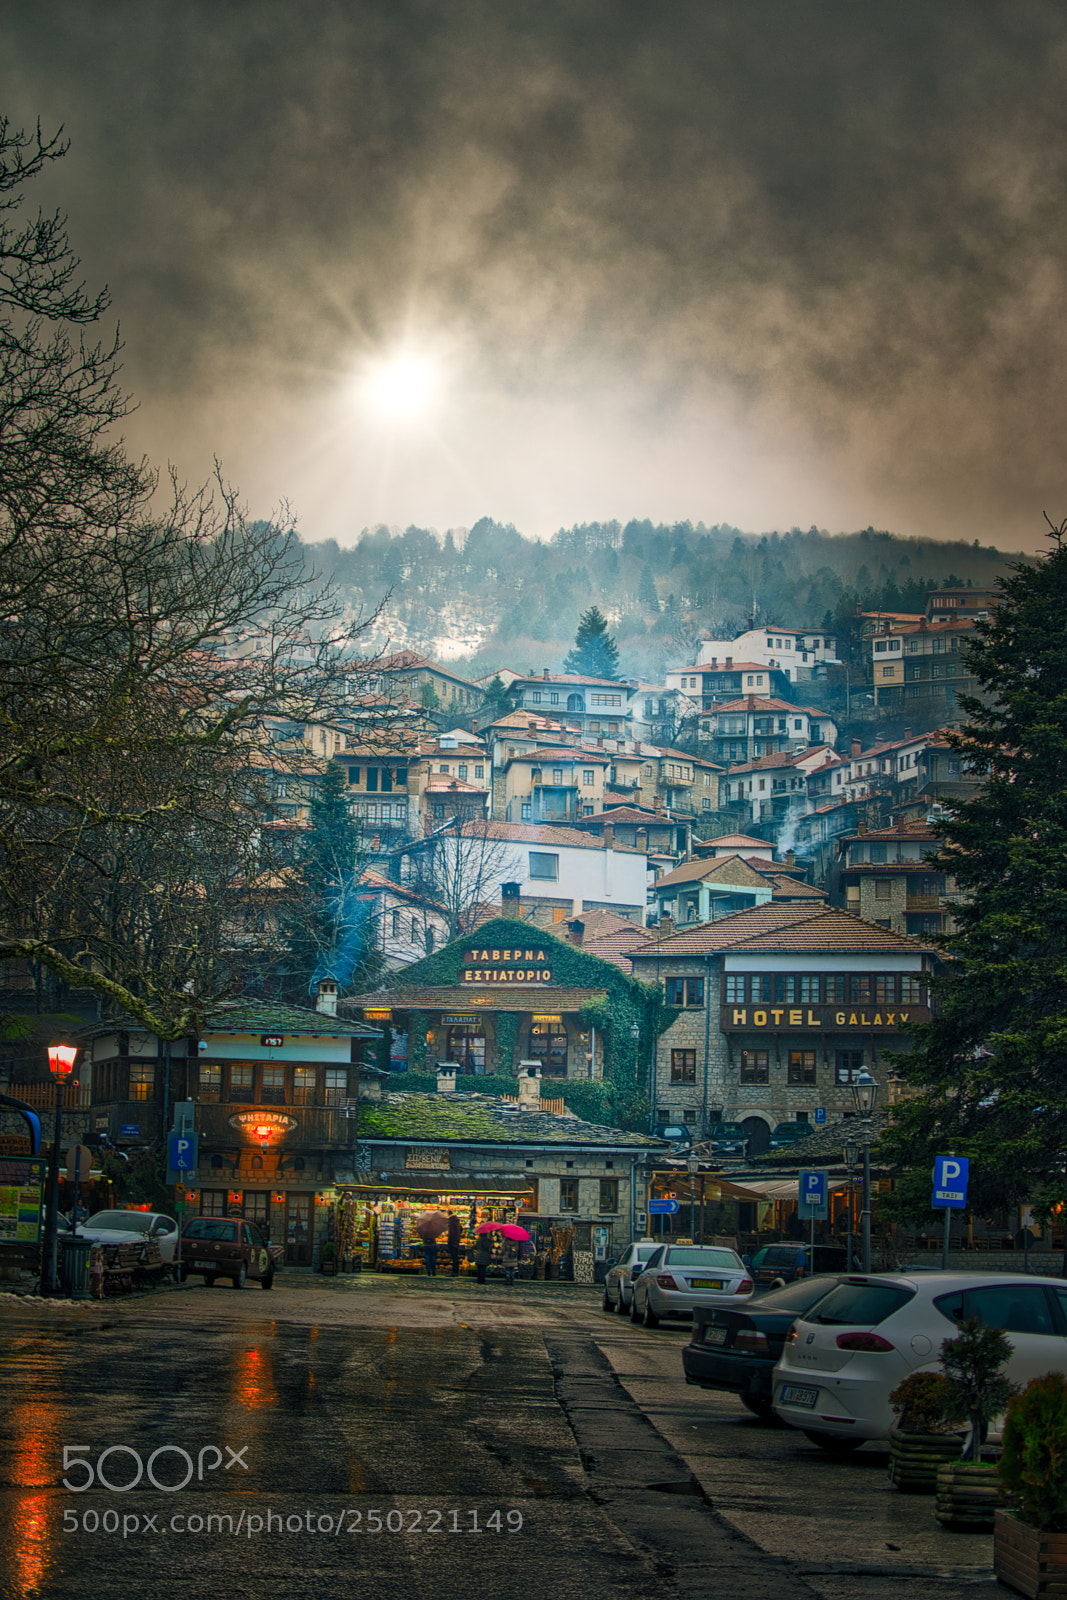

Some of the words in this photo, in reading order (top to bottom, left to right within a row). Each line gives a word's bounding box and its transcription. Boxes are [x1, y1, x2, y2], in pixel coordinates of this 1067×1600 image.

[471, 949, 546, 961] ΤΑΒΕΡΝΑ
[464, 970, 552, 981] ΕΣΤΙΑΤΟΡΙΟ
[732, 1009, 822, 1027] HOTEL
[836, 1012, 910, 1026] GALAXY
[239, 1113, 289, 1125] ΨΗΣΤΑΡΙΑ
[941, 1160, 961, 1188] P
[808, 1176, 819, 1190] P
